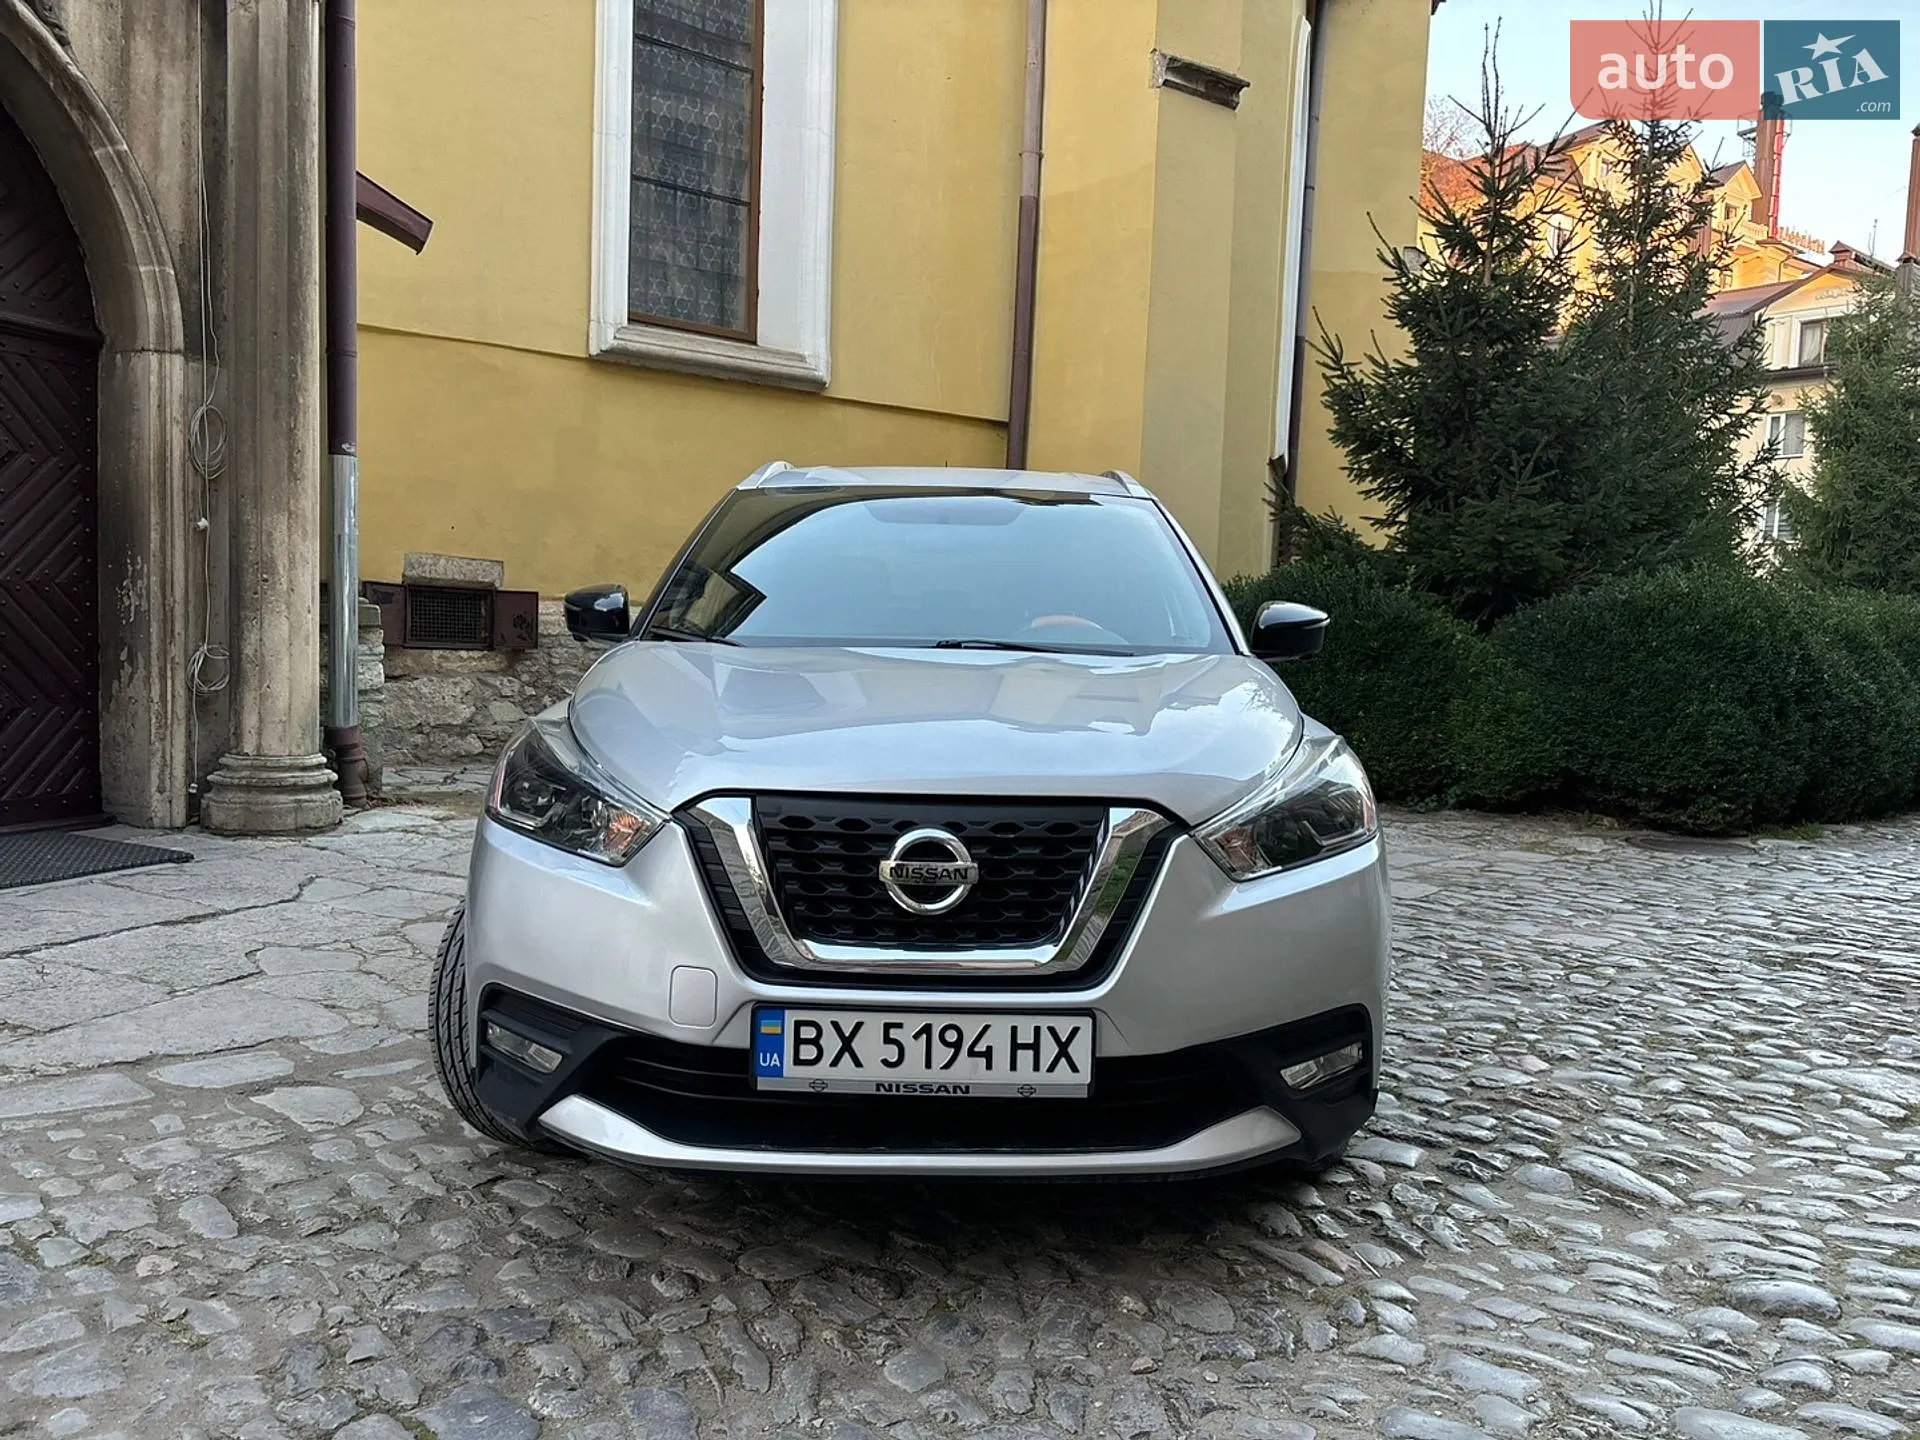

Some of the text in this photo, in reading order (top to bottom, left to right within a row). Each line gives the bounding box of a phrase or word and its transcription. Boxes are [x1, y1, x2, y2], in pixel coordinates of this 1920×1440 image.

[889, 866, 968, 881] NISSAN
[792, 1019, 1081, 1073] BX 5194 HX
[759, 1052, 781, 1068] UA
[875, 1082, 971, 1096] NISSAN
